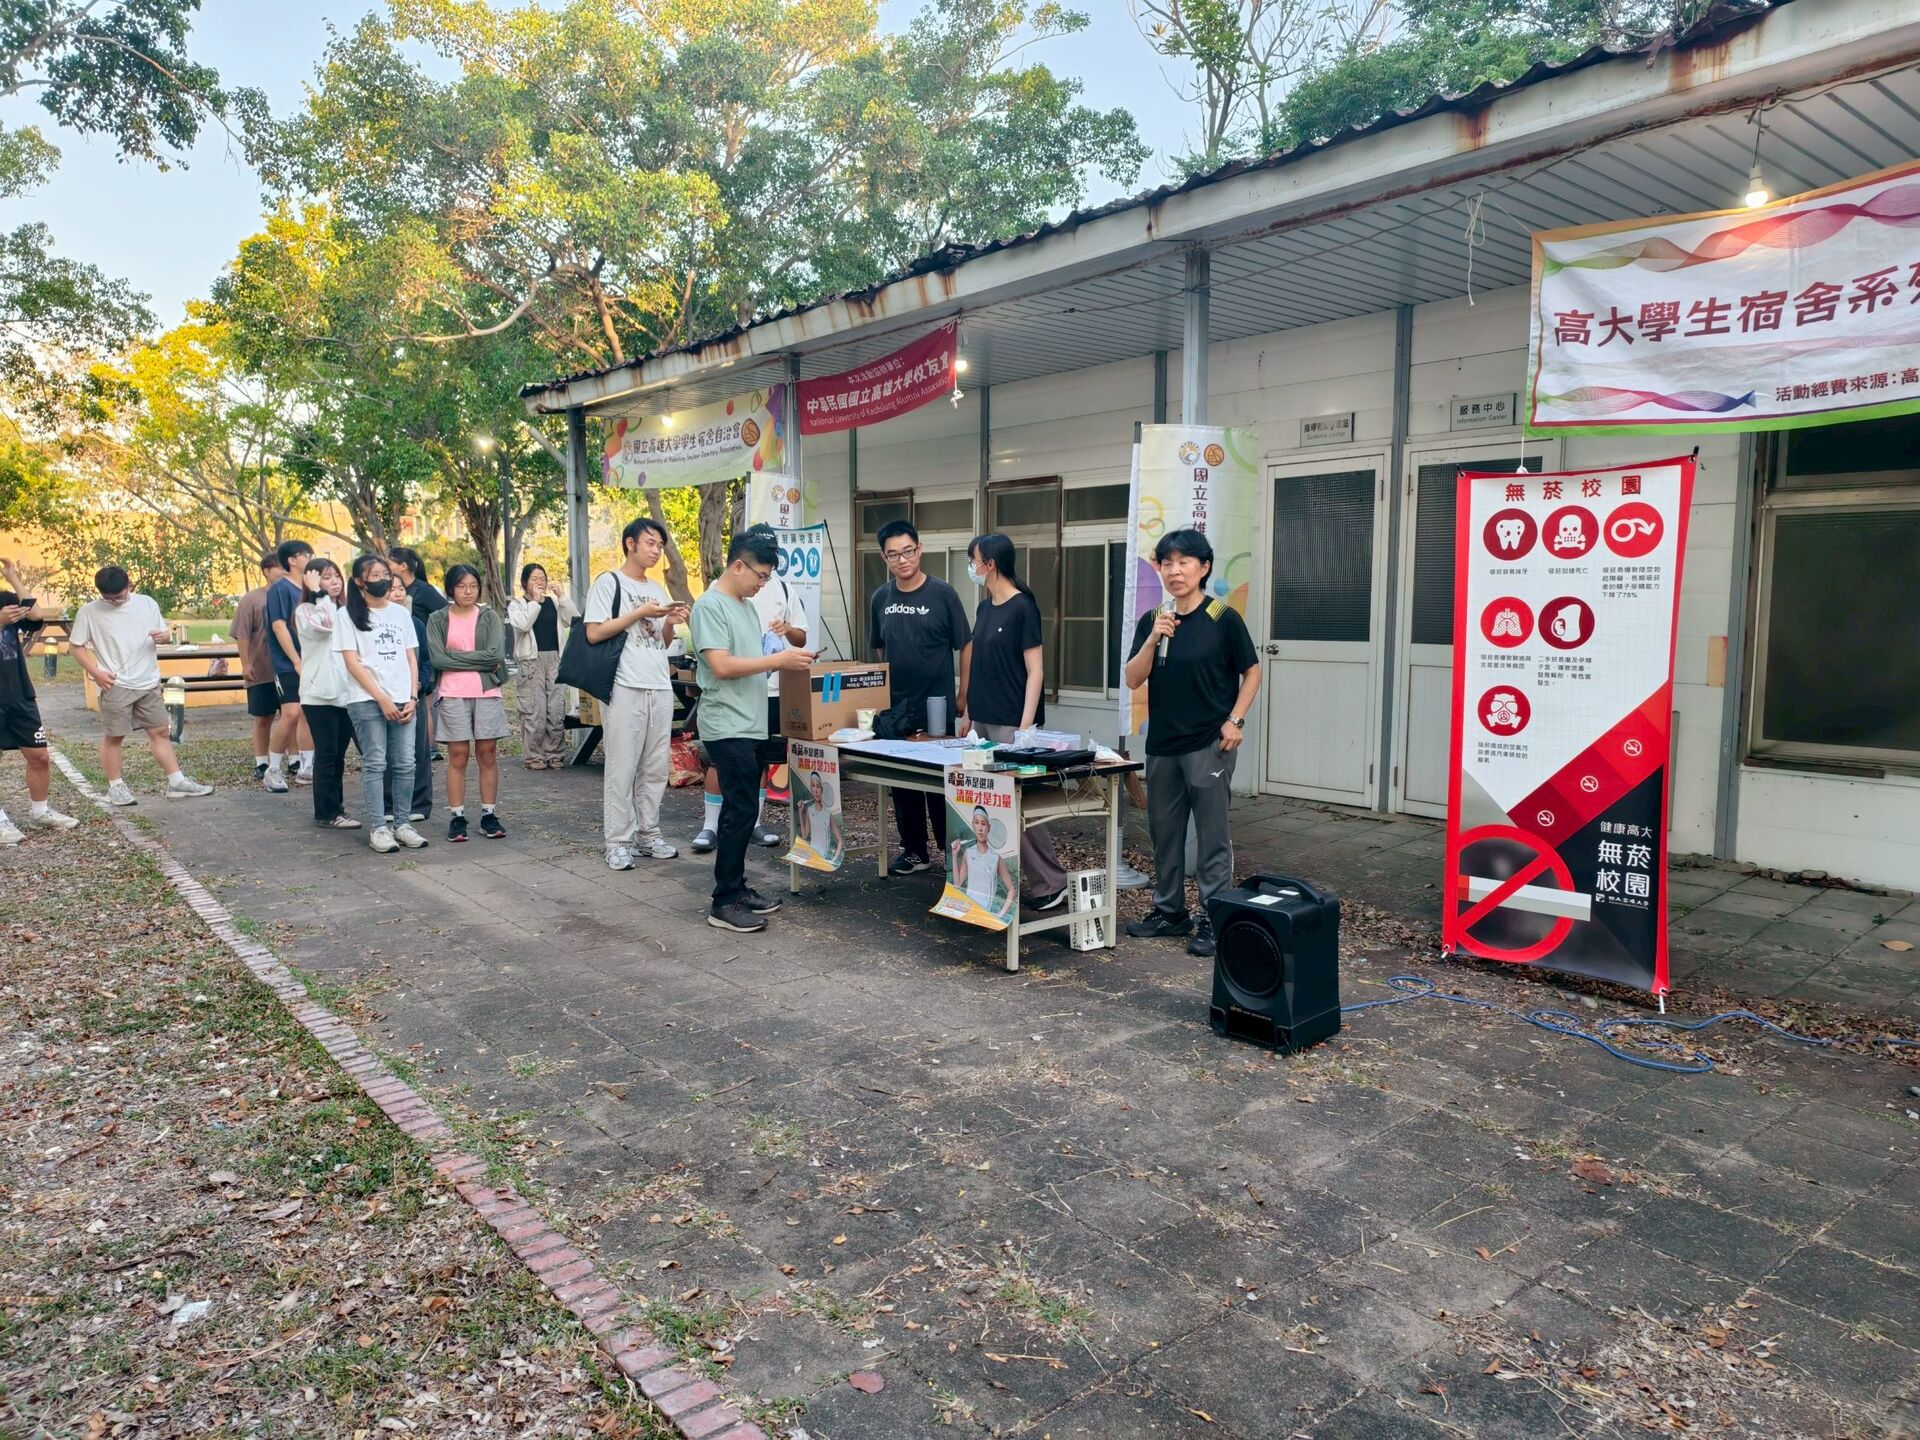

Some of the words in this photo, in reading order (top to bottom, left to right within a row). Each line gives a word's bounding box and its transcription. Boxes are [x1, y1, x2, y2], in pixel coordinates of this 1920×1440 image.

[1553, 261, 1920, 348] 高大學生宿舍系
[807, 351, 949, 414] 中華民國國立高雄大學校友會
[1459, 401, 1504, 415] 服務中心
[810, 413, 835, 426] National
[836, 410, 860, 423] University
[1457, 416, 1486, 424] Information
[633, 421, 742, 455] 國立高雄大學學生宿舍自治會
[1504, 475, 1642, 502] 無菸校園
[884, 603, 915, 614] adidas
[797, 757, 837, 774] 清醒才是力量
[947, 772, 995, 790] 毒品不是選項
[955, 788, 1012, 809] 清醒才是力量
[1600, 821, 1653, 839] 健康高大
[1598, 840, 1652, 869] 無菸
[1596, 868, 1650, 897] 校園
